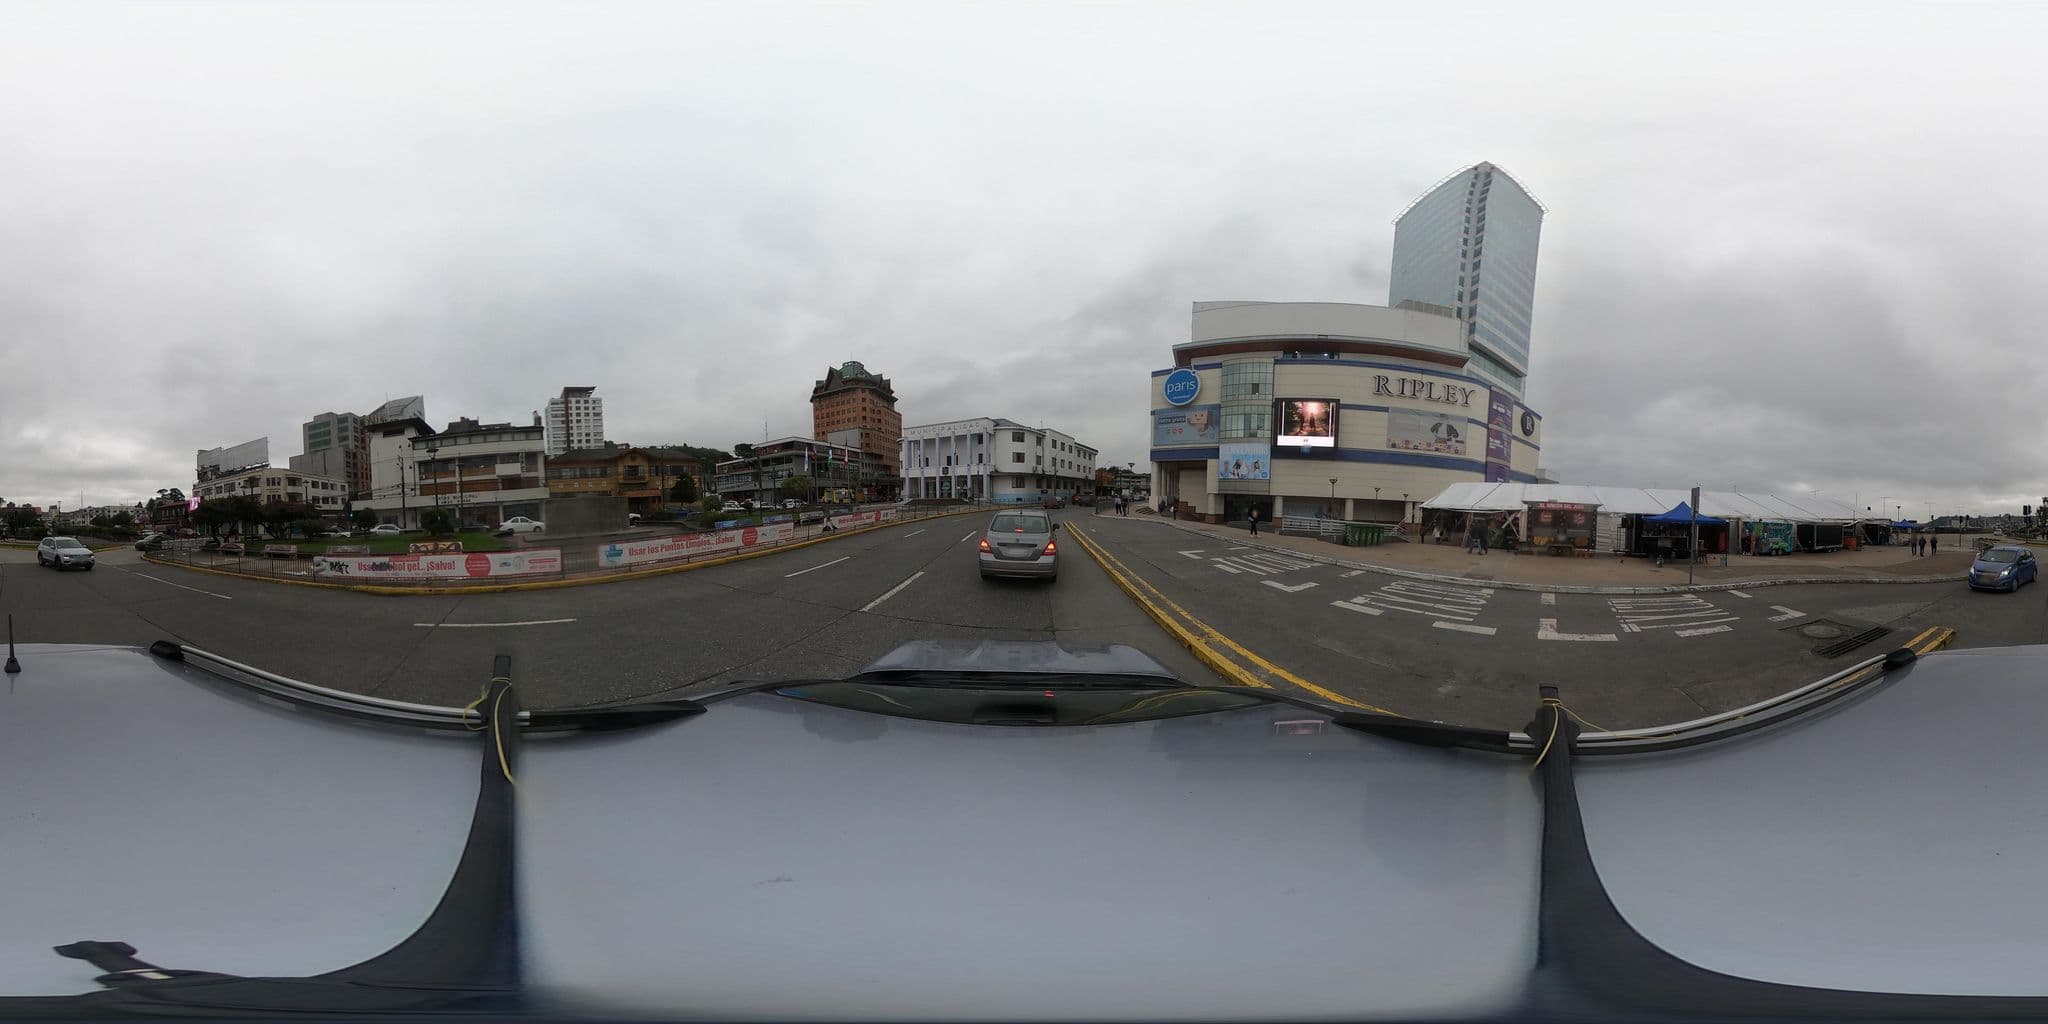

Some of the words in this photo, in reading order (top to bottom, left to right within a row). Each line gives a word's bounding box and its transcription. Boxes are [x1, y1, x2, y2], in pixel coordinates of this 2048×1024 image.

[1167, 379, 1196, 395] paris
[1374, 375, 1475, 406] RIPLEY
[910, 422, 980, 435] MUNICIPALIDAD
